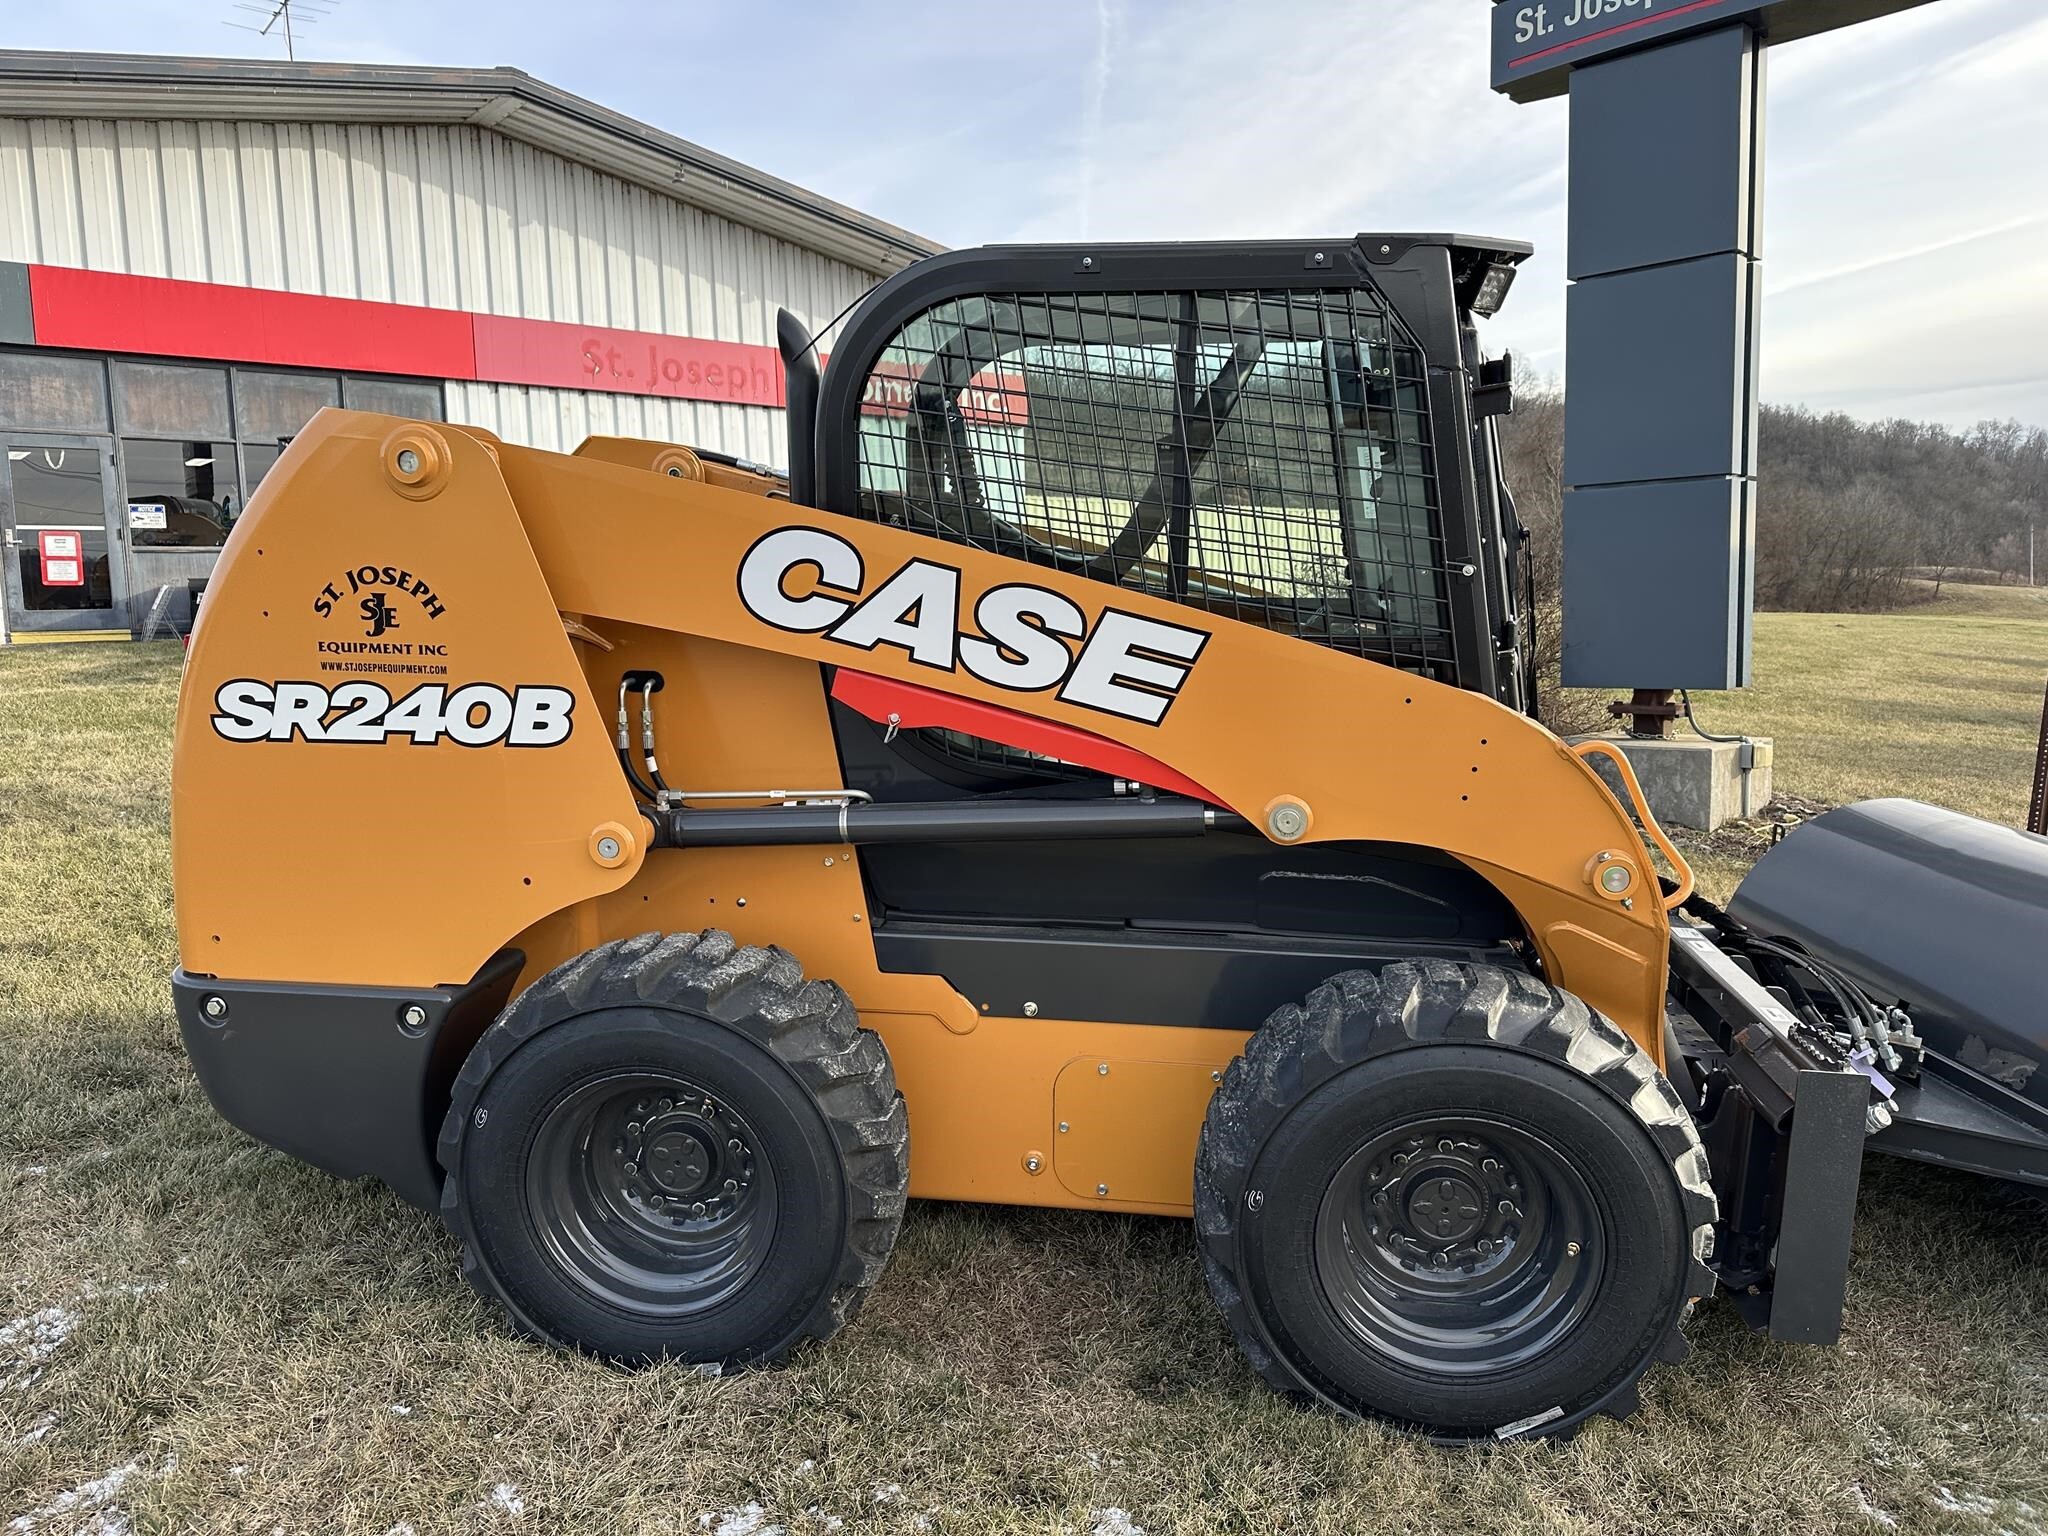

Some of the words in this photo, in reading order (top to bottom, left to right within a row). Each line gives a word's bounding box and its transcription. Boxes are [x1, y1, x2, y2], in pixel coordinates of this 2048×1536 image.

[1515, 4, 1554, 43] St.
[1564, 0, 1652, 26] Jos
[582, 338, 635, 378] St.
[646, 345, 769, 399] Joseph
[314, 582, 344, 618] ST.
[345, 566, 446, 619] JOSEPH
[318, 641, 413, 655] EQUIPMENT
[418, 645, 448, 656] INC
[737, 525, 1213, 728] CASE
[320, 661, 448, 675] WWW.STJOSEPHEQUIPMENT.COM
[210, 678, 576, 749] SR240B
